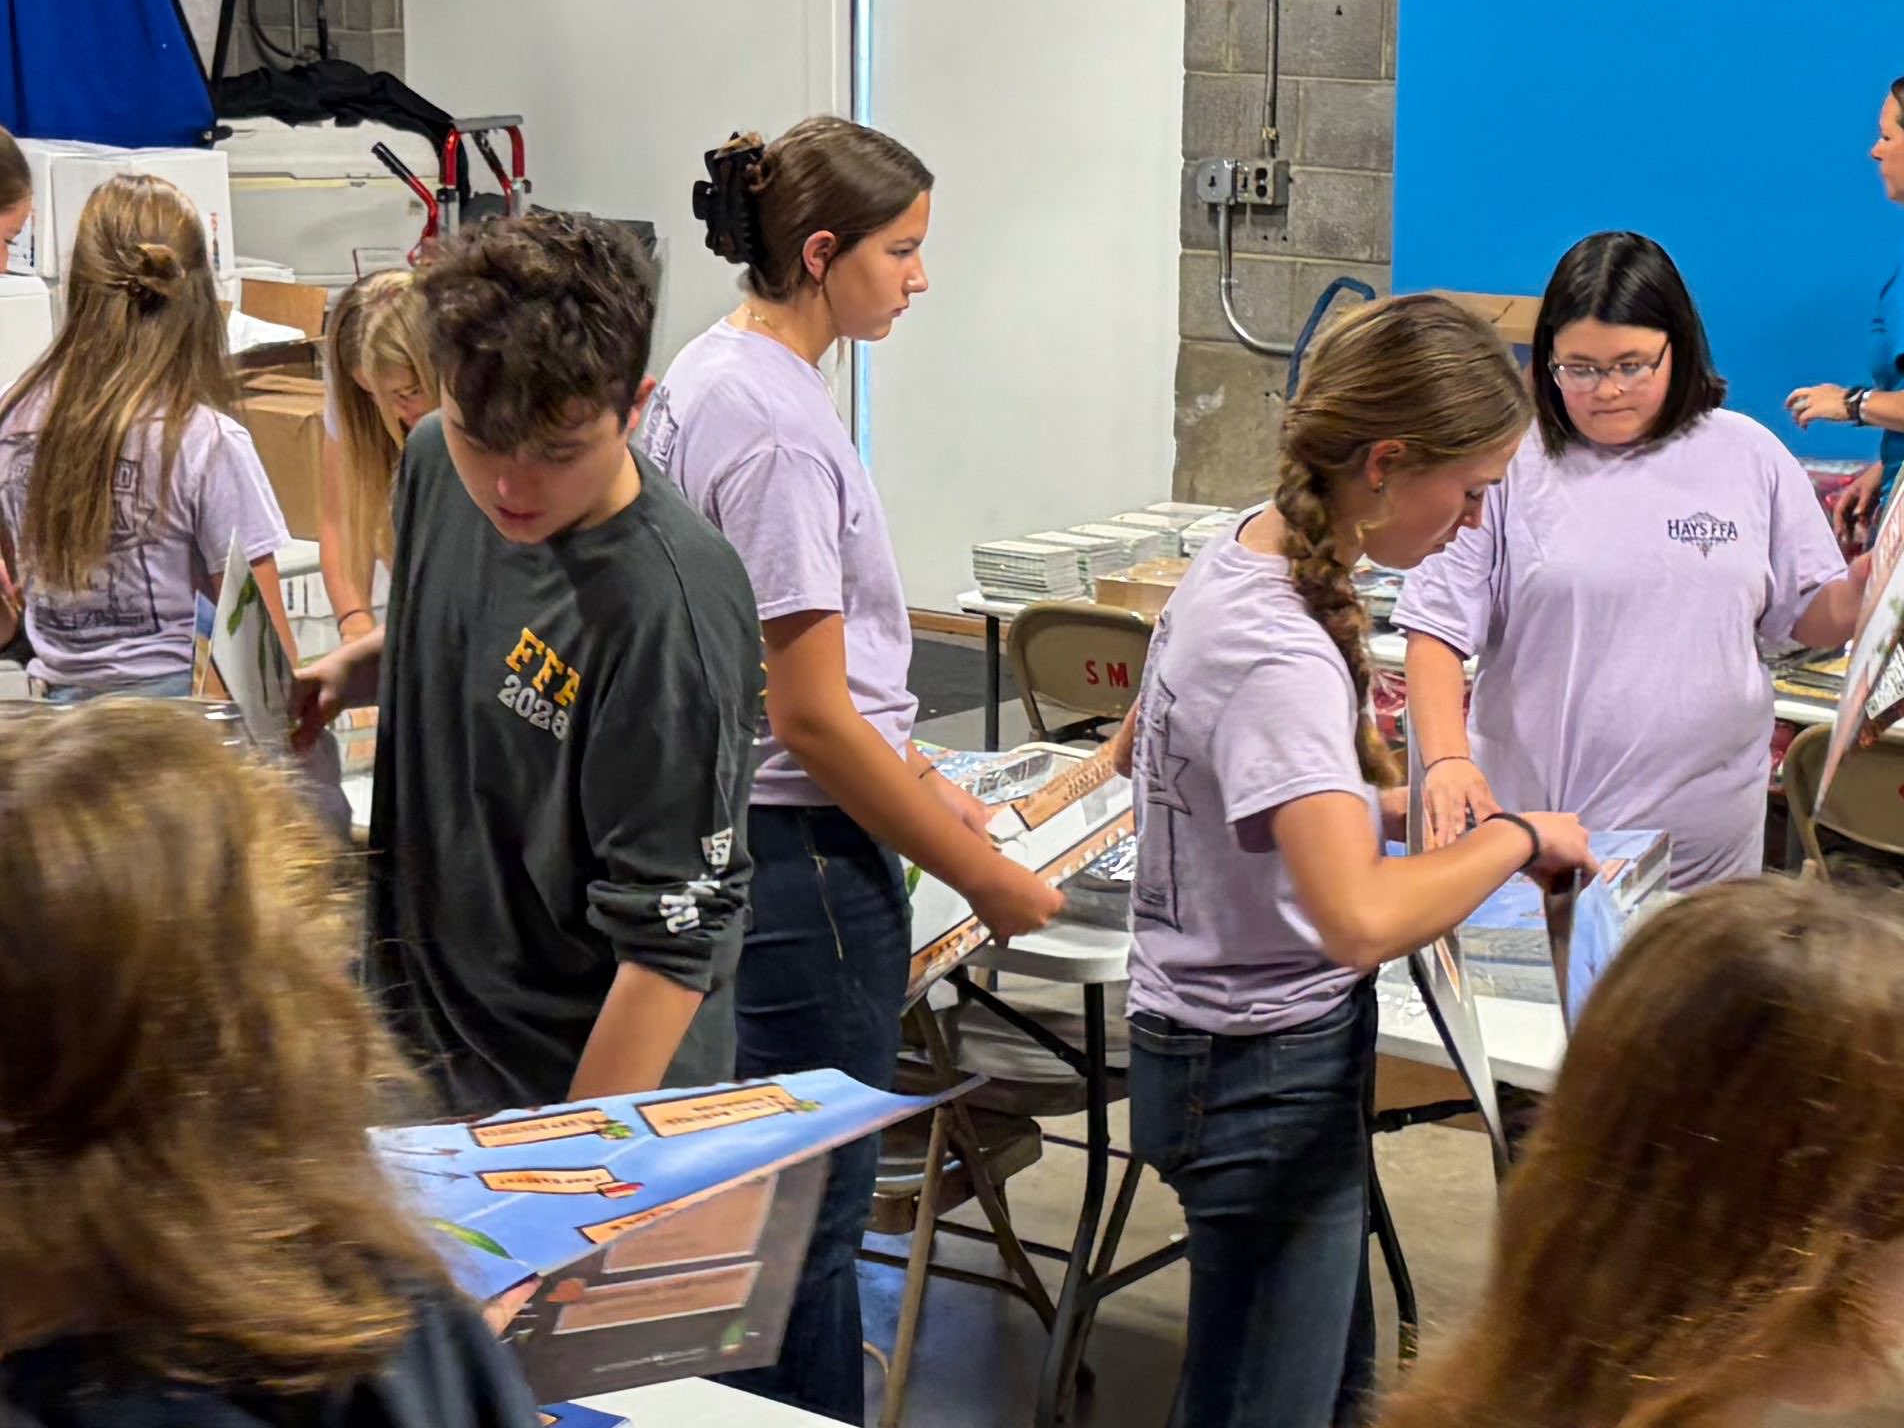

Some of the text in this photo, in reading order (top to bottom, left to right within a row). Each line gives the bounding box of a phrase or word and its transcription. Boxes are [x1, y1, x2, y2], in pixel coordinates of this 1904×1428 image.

[1667, 519, 1738, 541] HAYS FFA
[505, 627, 582, 706] FFA
[1085, 658, 1129, 689] S M
